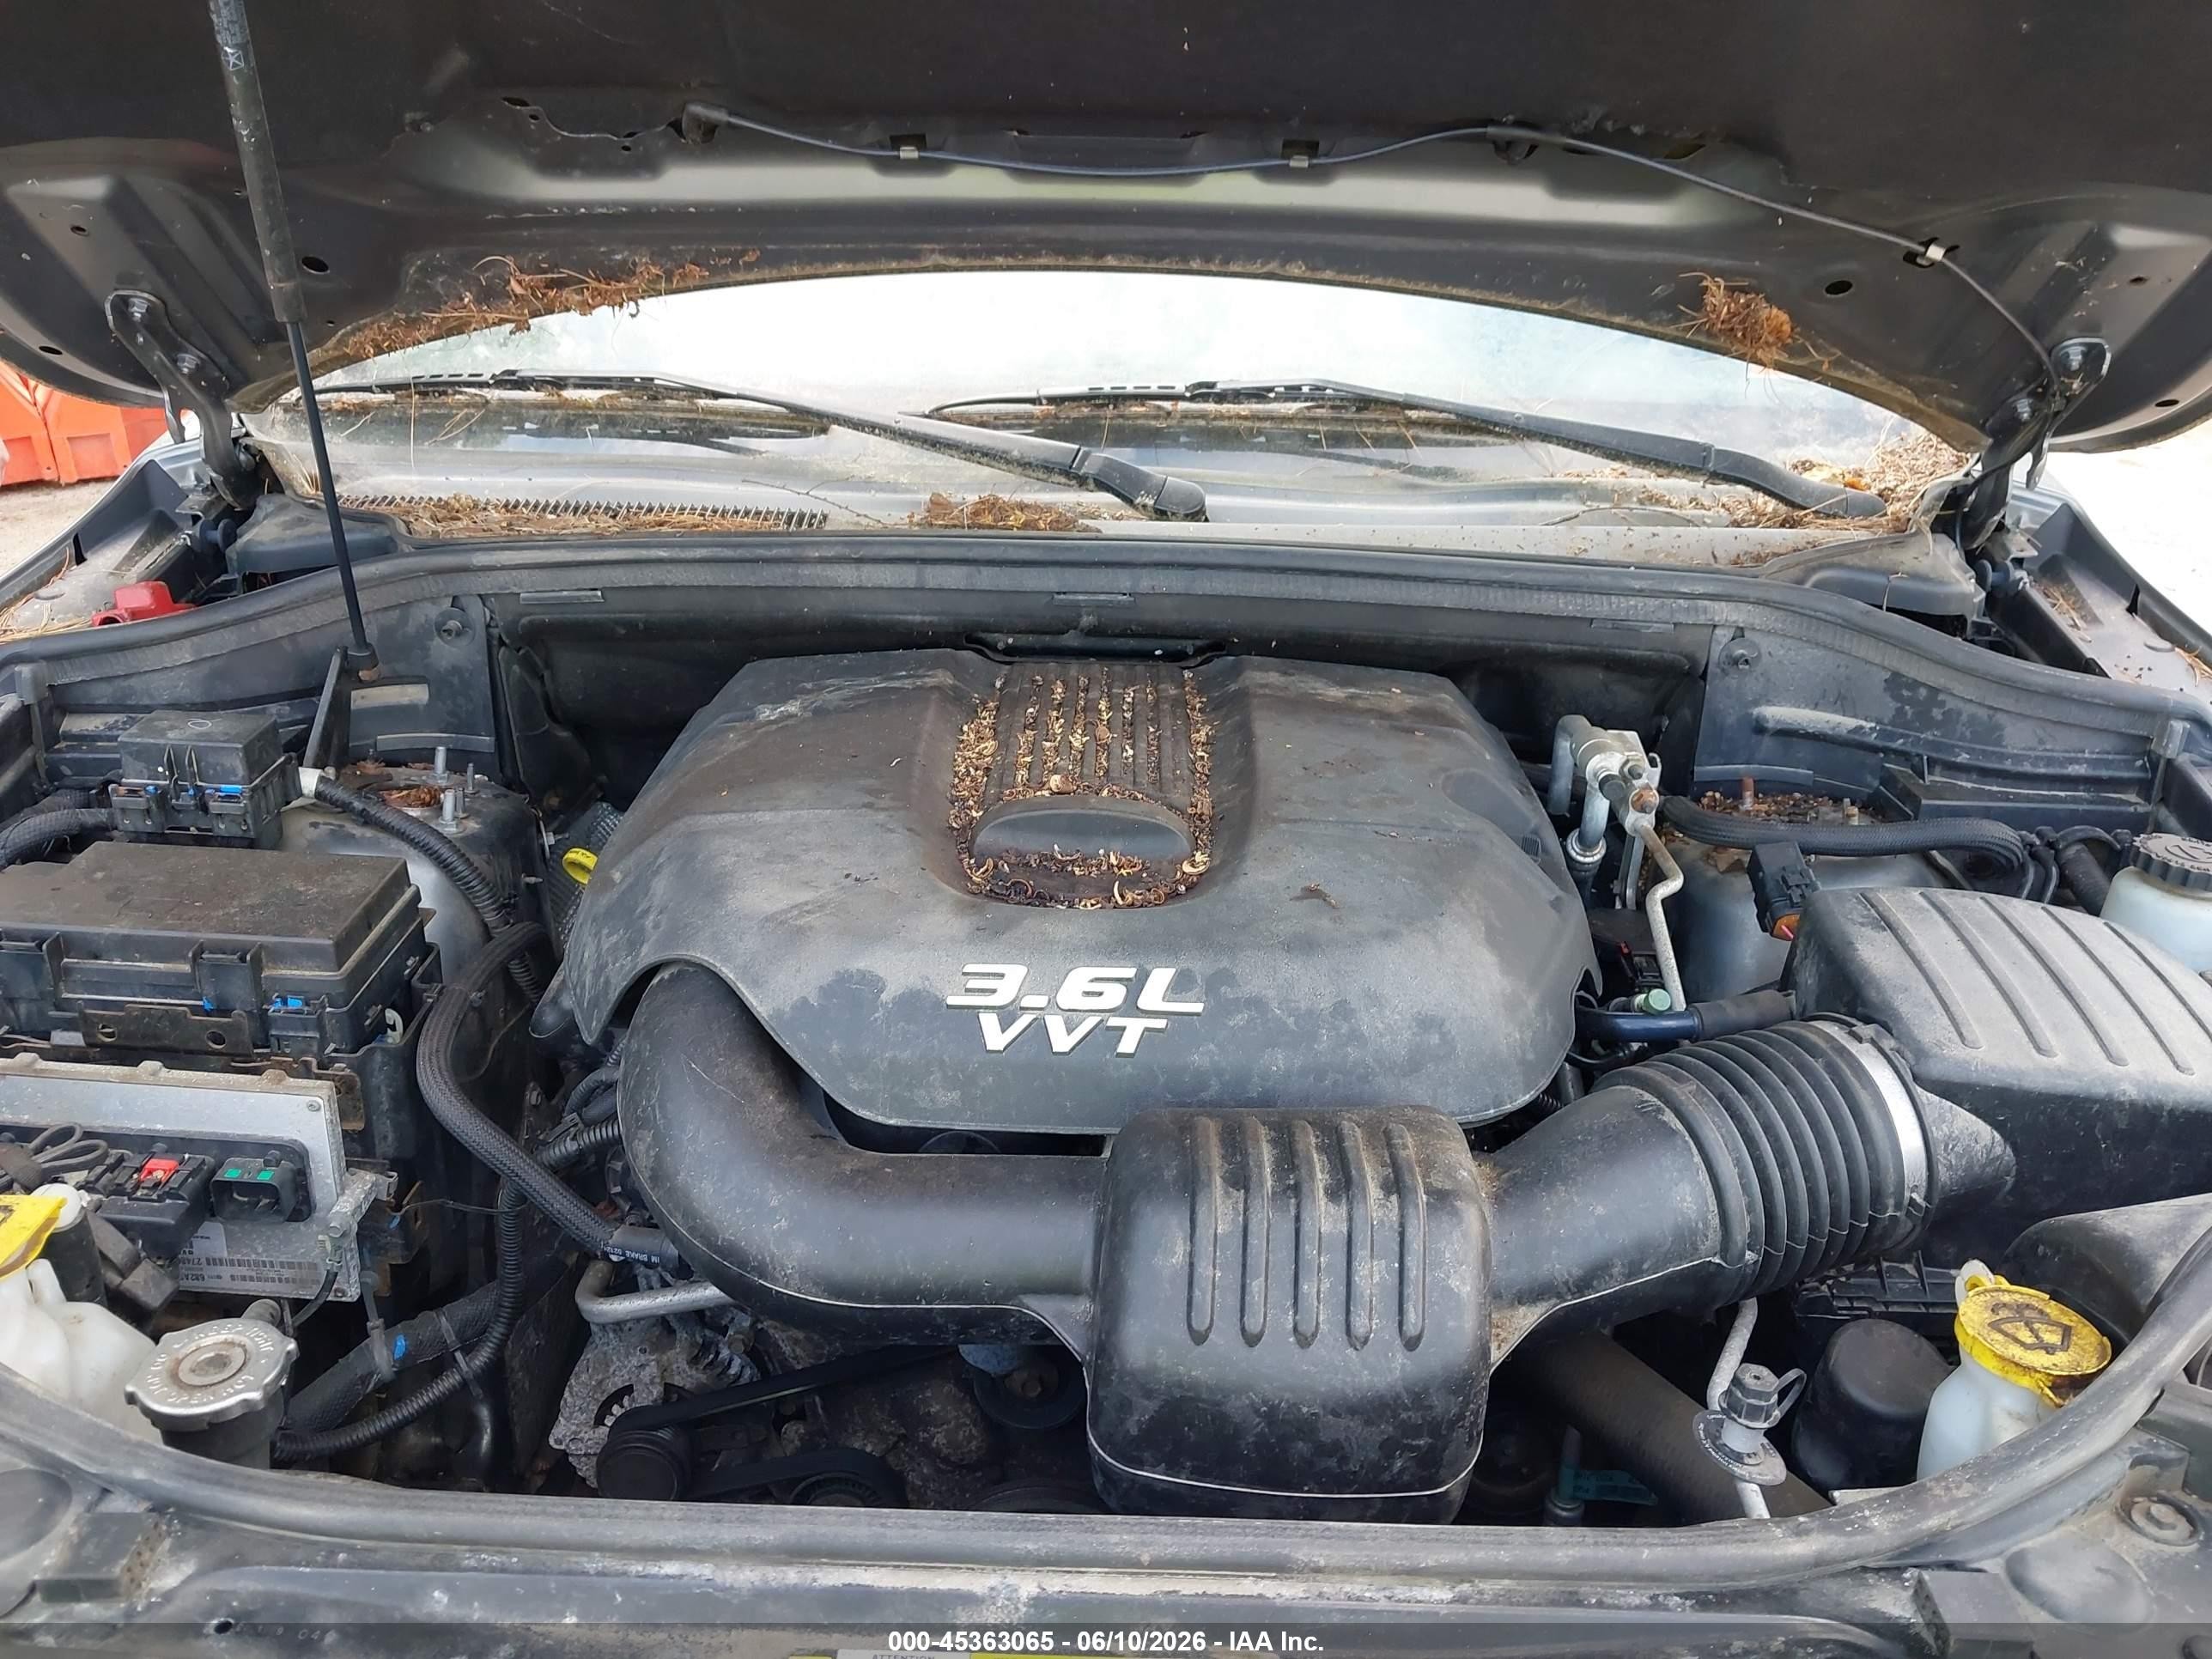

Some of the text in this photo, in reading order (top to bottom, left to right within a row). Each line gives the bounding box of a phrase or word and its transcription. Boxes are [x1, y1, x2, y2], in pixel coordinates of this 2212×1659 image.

[946, 963, 1205, 1016] 3.6L
[977, 1012, 1169, 1058] VVT
[625, 1250, 648, 1262] BRAKE
